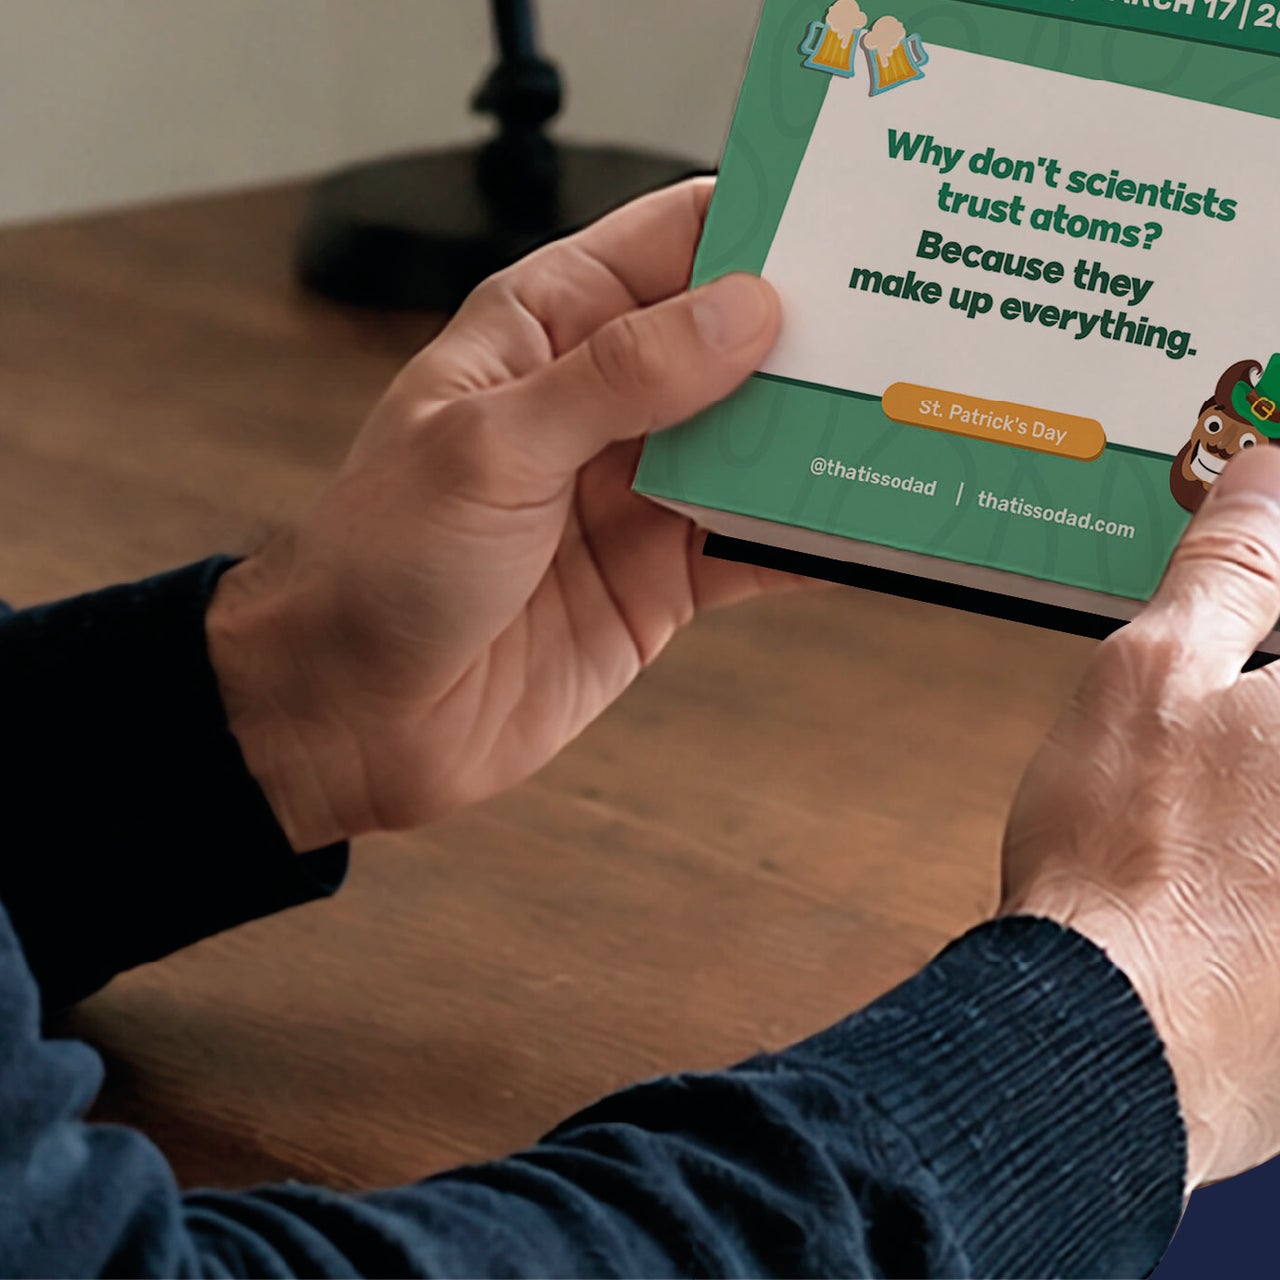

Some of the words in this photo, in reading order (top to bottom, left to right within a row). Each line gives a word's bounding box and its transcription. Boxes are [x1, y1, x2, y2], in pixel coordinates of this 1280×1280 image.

[887, 128, 965, 174] Why
[968, 147, 1062, 188] don't
[1066, 170, 1238, 222] scientists
[937, 182, 1025, 226] trust
[1030, 205, 1163, 250] atoms?
[916, 229, 1064, 283] Because
[1073, 259, 1154, 306] they
[848, 267, 942, 304] make
[948, 287, 993, 319] up
[1000, 297, 1197, 360] everything.
[918, 399, 944, 418] St.
[949, 404, 1028, 435] Patrick's
[1031, 421, 1068, 446] Day
[810, 457, 937, 496] @thatissodad
[977, 490, 1136, 539] thatissodad.com
